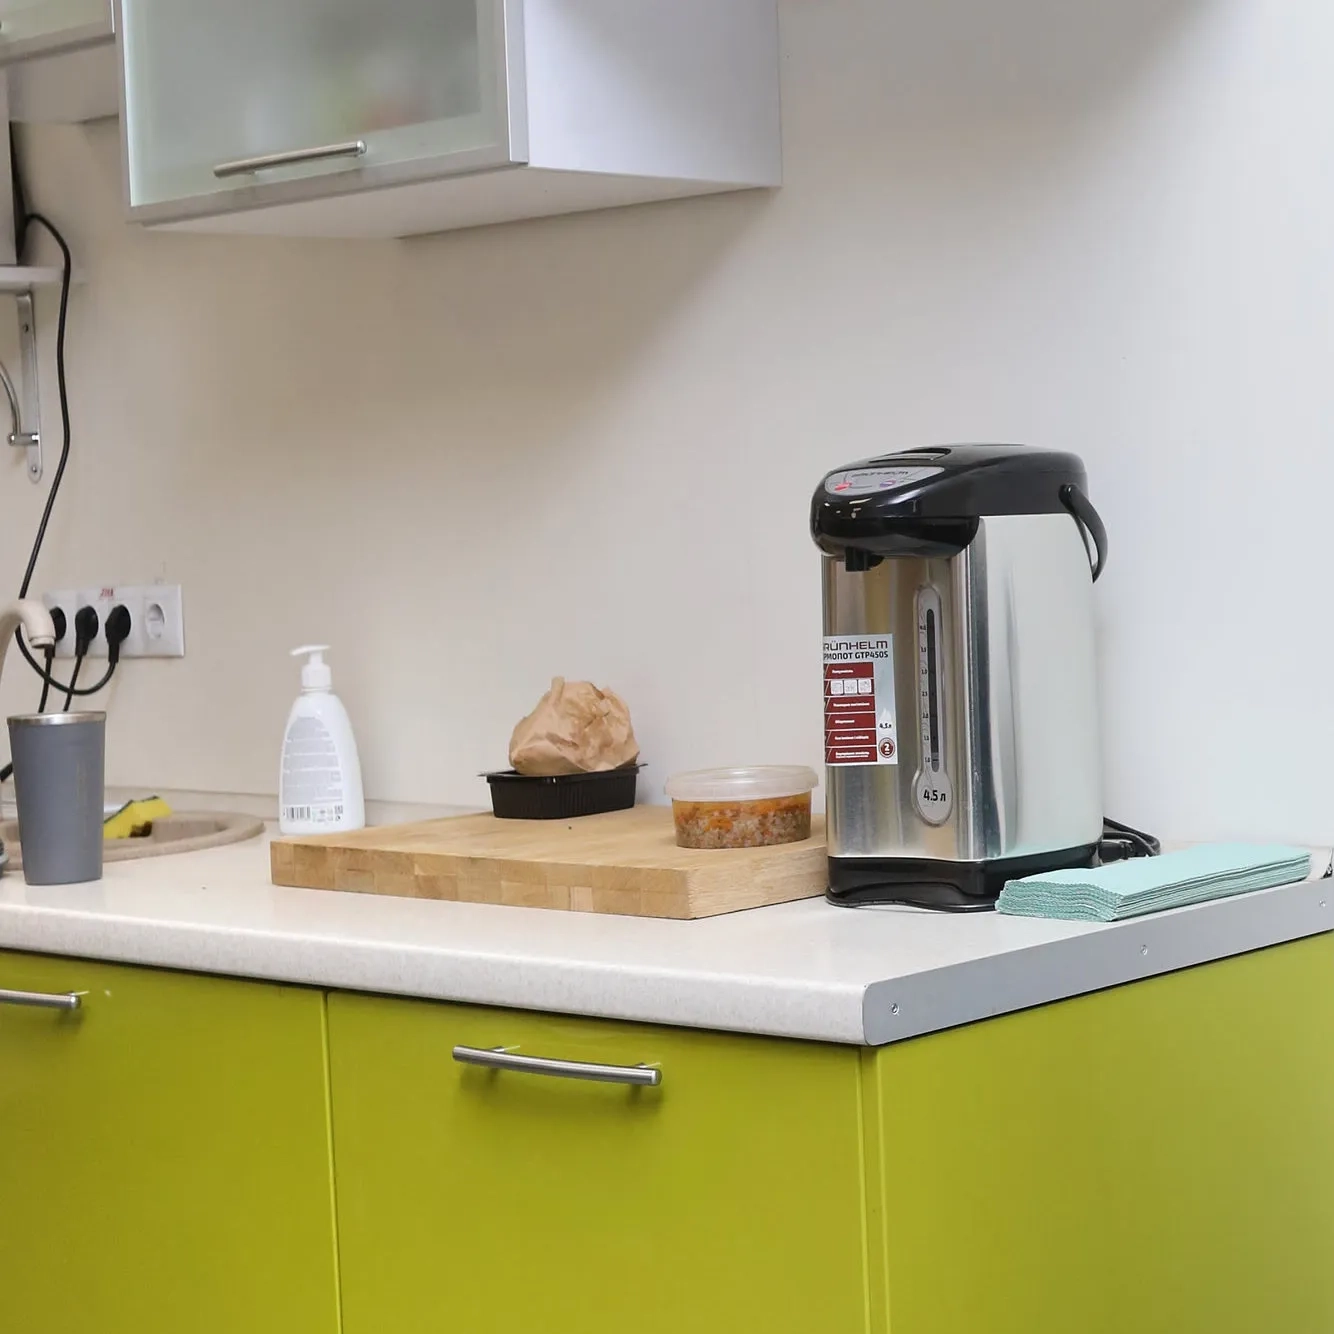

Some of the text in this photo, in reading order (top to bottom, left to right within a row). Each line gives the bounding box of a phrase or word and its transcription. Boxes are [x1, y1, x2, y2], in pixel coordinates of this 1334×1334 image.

[854, 650, 889, 659] GTP450S
[884, 743, 891, 752] 2
[923, 789, 939, 801] 4.5
